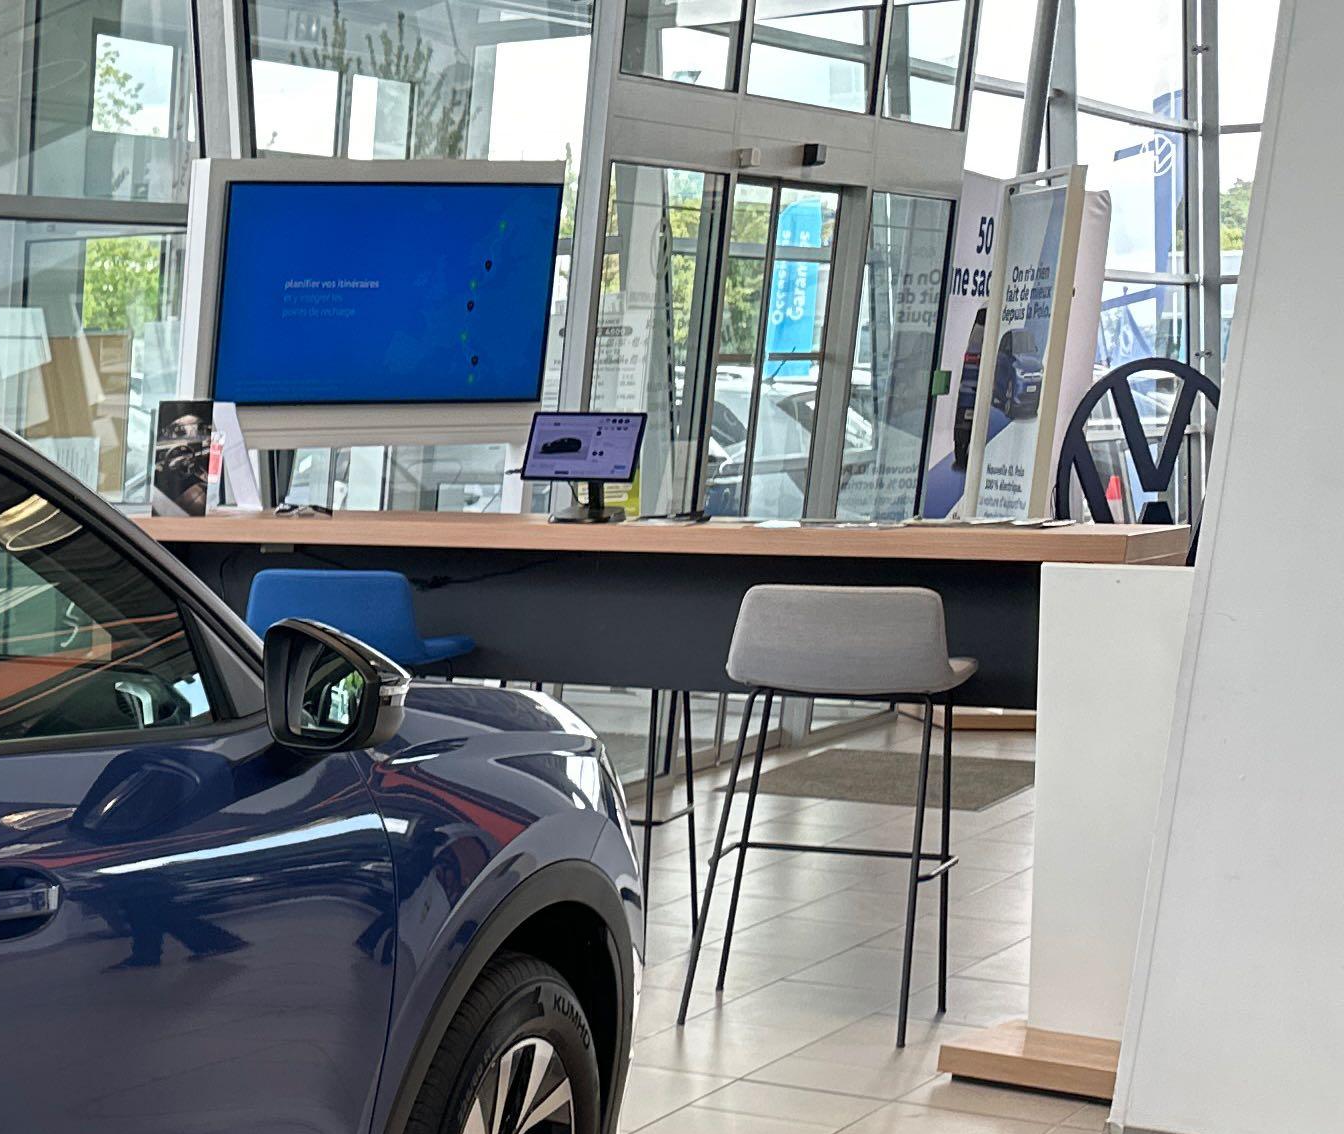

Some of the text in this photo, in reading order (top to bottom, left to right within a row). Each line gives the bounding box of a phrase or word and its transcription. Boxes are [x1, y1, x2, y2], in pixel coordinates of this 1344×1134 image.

[976, 216, 995, 256] 50
[1012, 265, 1024, 284] On
[1020, 284, 1030, 302] de
[1030, 281, 1053, 300] mieux
[1001, 302, 1026, 325] depuis
[552, 993, 592, 1049] KUMHO
